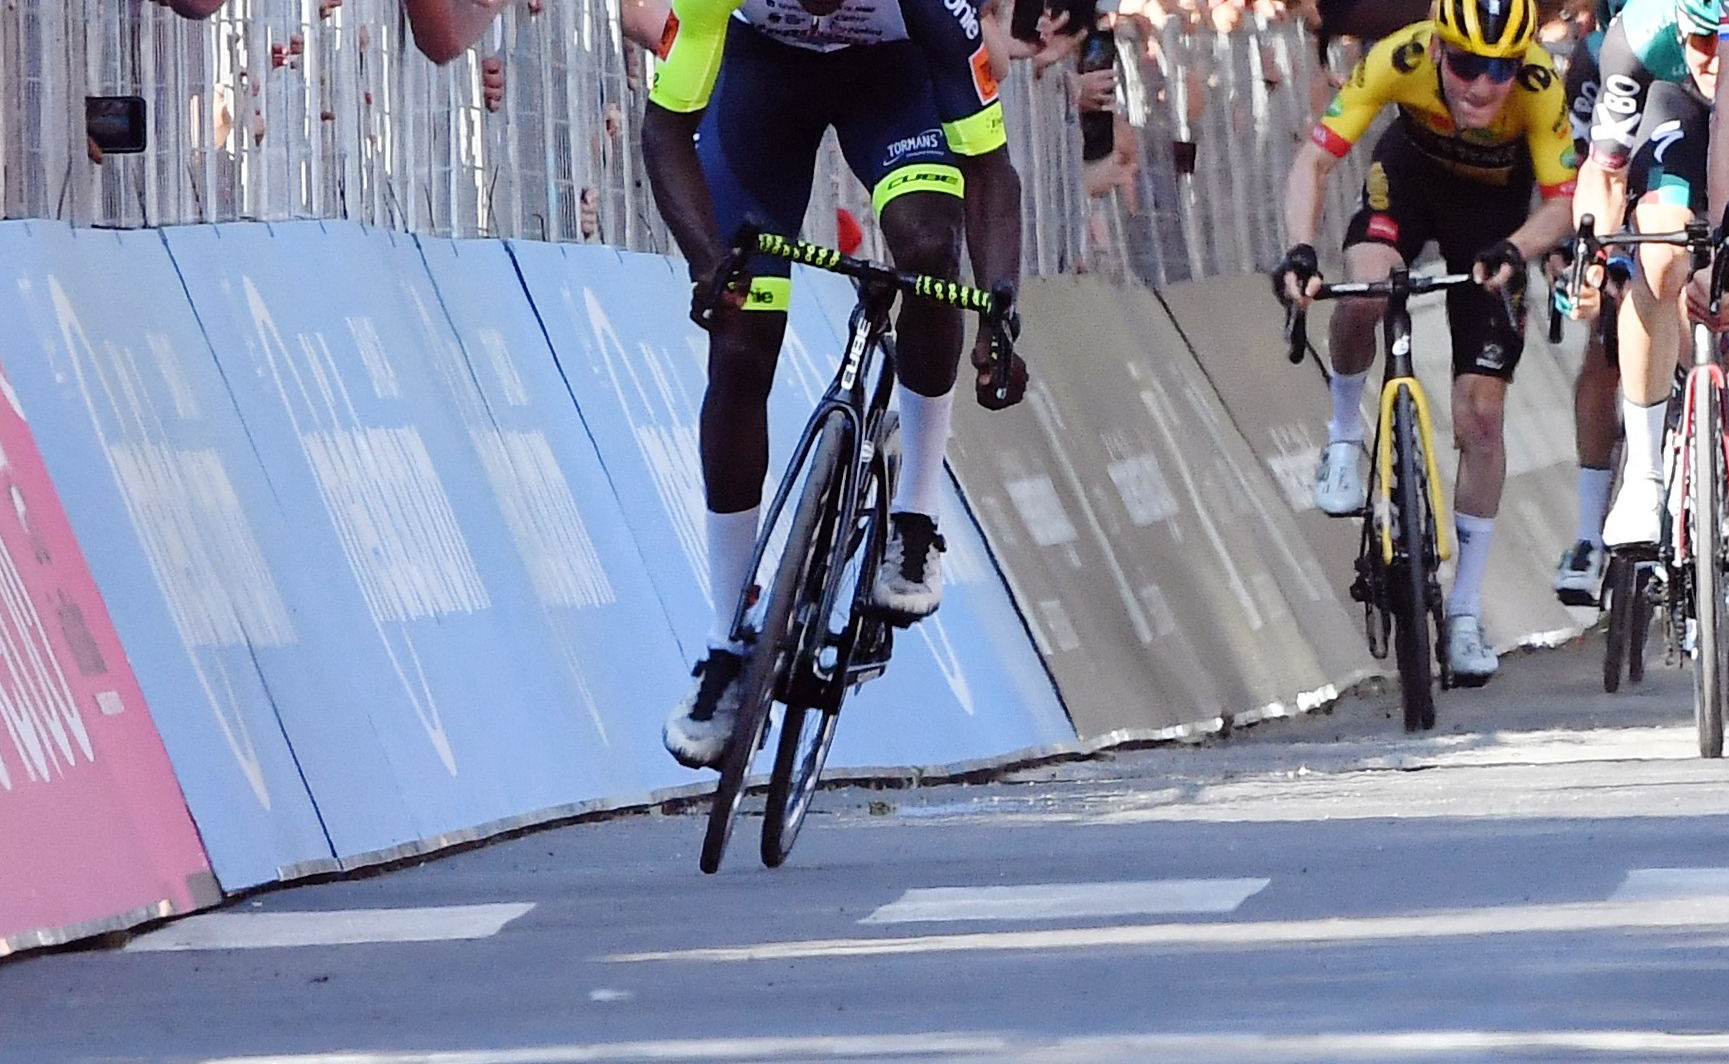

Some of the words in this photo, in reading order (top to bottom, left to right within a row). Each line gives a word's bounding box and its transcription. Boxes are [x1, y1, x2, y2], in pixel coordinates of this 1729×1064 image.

[886, 133, 939, 158] TORMANS
[887, 172, 959, 191] CUBE
[840, 317, 872, 391] CUBE
